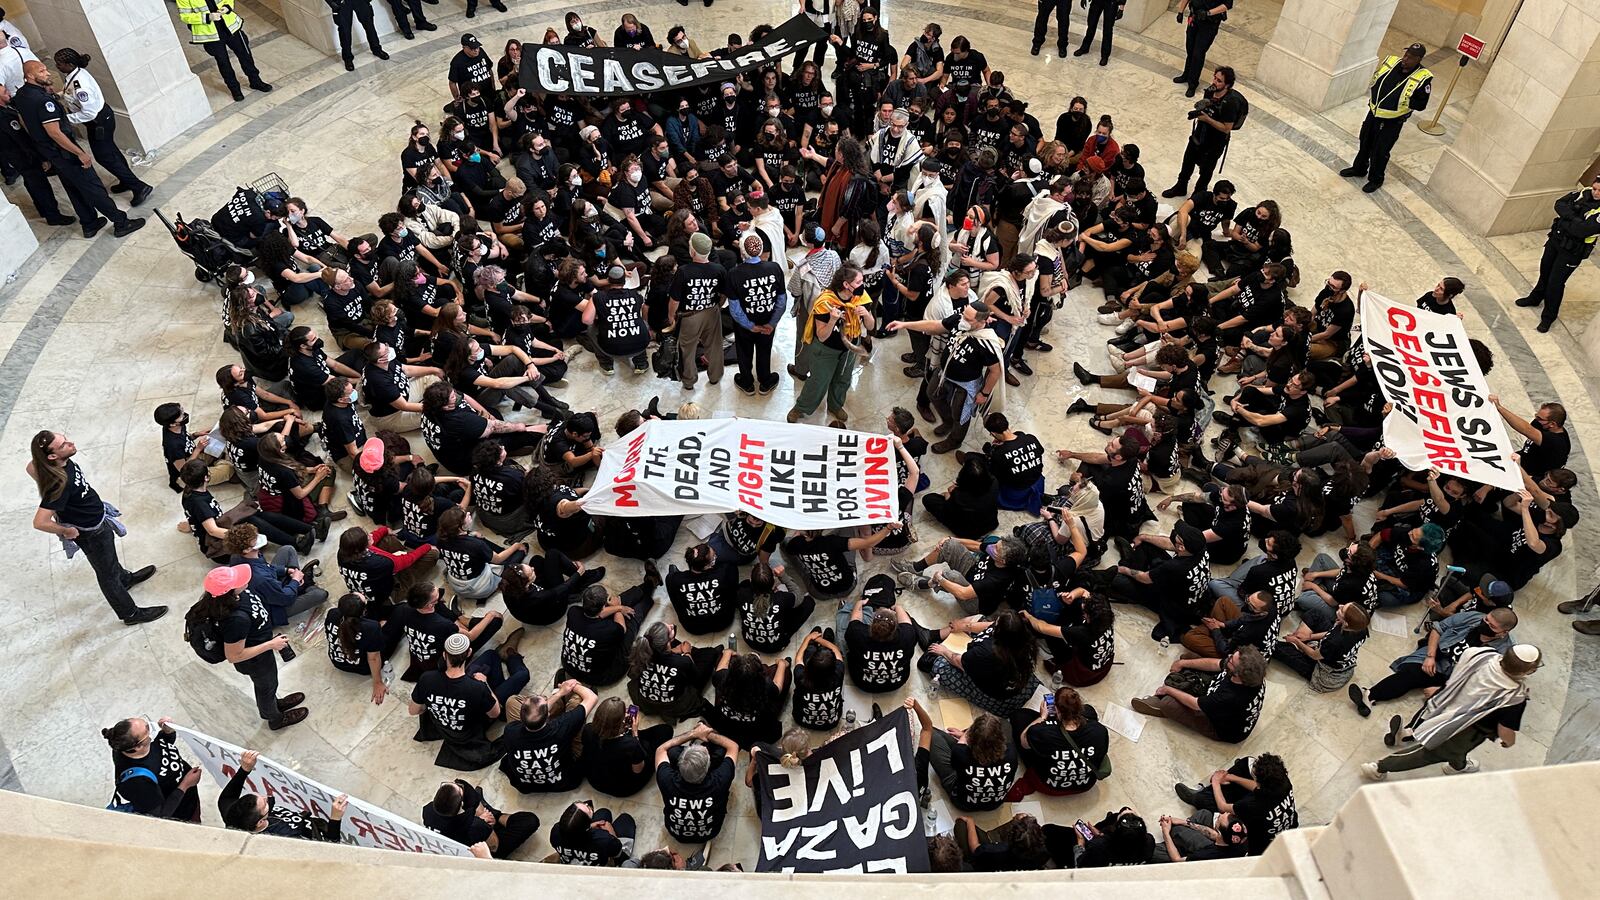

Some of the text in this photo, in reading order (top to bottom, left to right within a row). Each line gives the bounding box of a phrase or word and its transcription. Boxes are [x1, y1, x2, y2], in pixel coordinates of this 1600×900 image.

[857, 47, 874, 56] OUR
[467, 63, 480, 72] NOT
[473, 67, 488, 76] OUR
[471, 72, 491, 83] NAME
[470, 116, 488, 124] OUR
[555, 112, 572, 120] OUR
[619, 131, 644, 141] NAME
[621, 126, 636, 135] OUR
[977, 129, 1000, 140] JEWS
[709, 150, 725, 160] OUR
[687, 279, 718, 287] JEWS
[743, 275, 776, 289] JEWS
[744, 285, 772, 294] SAY
[745, 291, 777, 302] CEASE
[1240, 292, 1250, 308] OUR
[606, 298, 636, 308] JEWS
[686, 303, 716, 311] NOW
[746, 302, 775, 314] NOW
[751, 299, 772, 307] FIRE
[610, 306, 633, 315] SAY
[607, 313, 638, 322] CEASE
[612, 321, 635, 329] FIRE
[608, 326, 640, 338] NOW
[1387, 306, 1469, 474] CEASEFIRE
[1425, 332, 1506, 472] JEWS SAY
[1005, 449, 1024, 460] NOT
[1013, 451, 1036, 466] OUR
[612, 432, 646, 508] MOURN
[674, 431, 706, 500] DEAD,
[708, 447, 731, 491] AND
[1011, 460, 1043, 475] NAME
[258, 467, 277, 484] EWS
[737, 434, 766, 510] FIGHT
[836, 434, 860, 521] FOR THE
[864, 437, 889, 519] LIVING
[770, 449, 796, 508] LIKE
[802, 444, 828, 513] HELL
[474, 483, 497, 495] SAY
[403, 507, 423, 522] SAY
[444, 557, 465, 569] SAY
[1186, 550, 1210, 579] JEWS
[1269, 567, 1297, 587] JEWS
[679, 578, 720, 593] JEWS
[1275, 577, 1296, 594] SAY
[686, 589, 715, 602] SAY
[686, 604, 721, 616] NOW
[689, 601, 717, 609] FIRE
[746, 614, 774, 623] SAY
[327, 622, 362, 641] JES
[743, 620, 779, 631] CEASE
[748, 627, 775, 636] FIRE
[745, 632, 780, 644] NOW
[1091, 626, 1114, 648] JEW
[863, 649, 904, 660] JEWS
[868, 660, 898, 670] SAY
[642, 670, 670, 684] SAY
[642, 686, 668, 697] FIRE
[803, 690, 841, 702] JEWS
[426, 693, 466, 708] JEWS
[808, 699, 840, 711] SAY
[431, 702, 459, 716] SAY
[169, 742, 181, 772] OUR
[514, 744, 558, 760] JEWS
[1051, 746, 1095, 760] JEWS
[159, 749, 169, 776] NOT
[516, 759, 560, 775] CEASE
[520, 756, 553, 769] SAY
[1056, 760, 1086, 770] SAY
[524, 771, 555, 780] FIRE
[965, 762, 1012, 777] JEWS
[520, 772, 562, 784] NOW
[971, 776, 1007, 787] SAY
[1046, 777, 1090, 788] NOW
[1055, 773, 1085, 783] FIRE
[966, 780, 1012, 794] CEASE
[967, 792, 1007, 804] NOW
[972, 790, 1005, 798] FIRE
[669, 796, 714, 810] JEWS
[1266, 789, 1294, 821] JEWS
[670, 814, 713, 827] CEASE
[674, 809, 708, 820] SAY
[670, 827, 713, 837] NOW
[674, 824, 707, 832] FIRE
[762, 791, 918, 861] GAZA
[556, 845, 598, 860] JEWS
